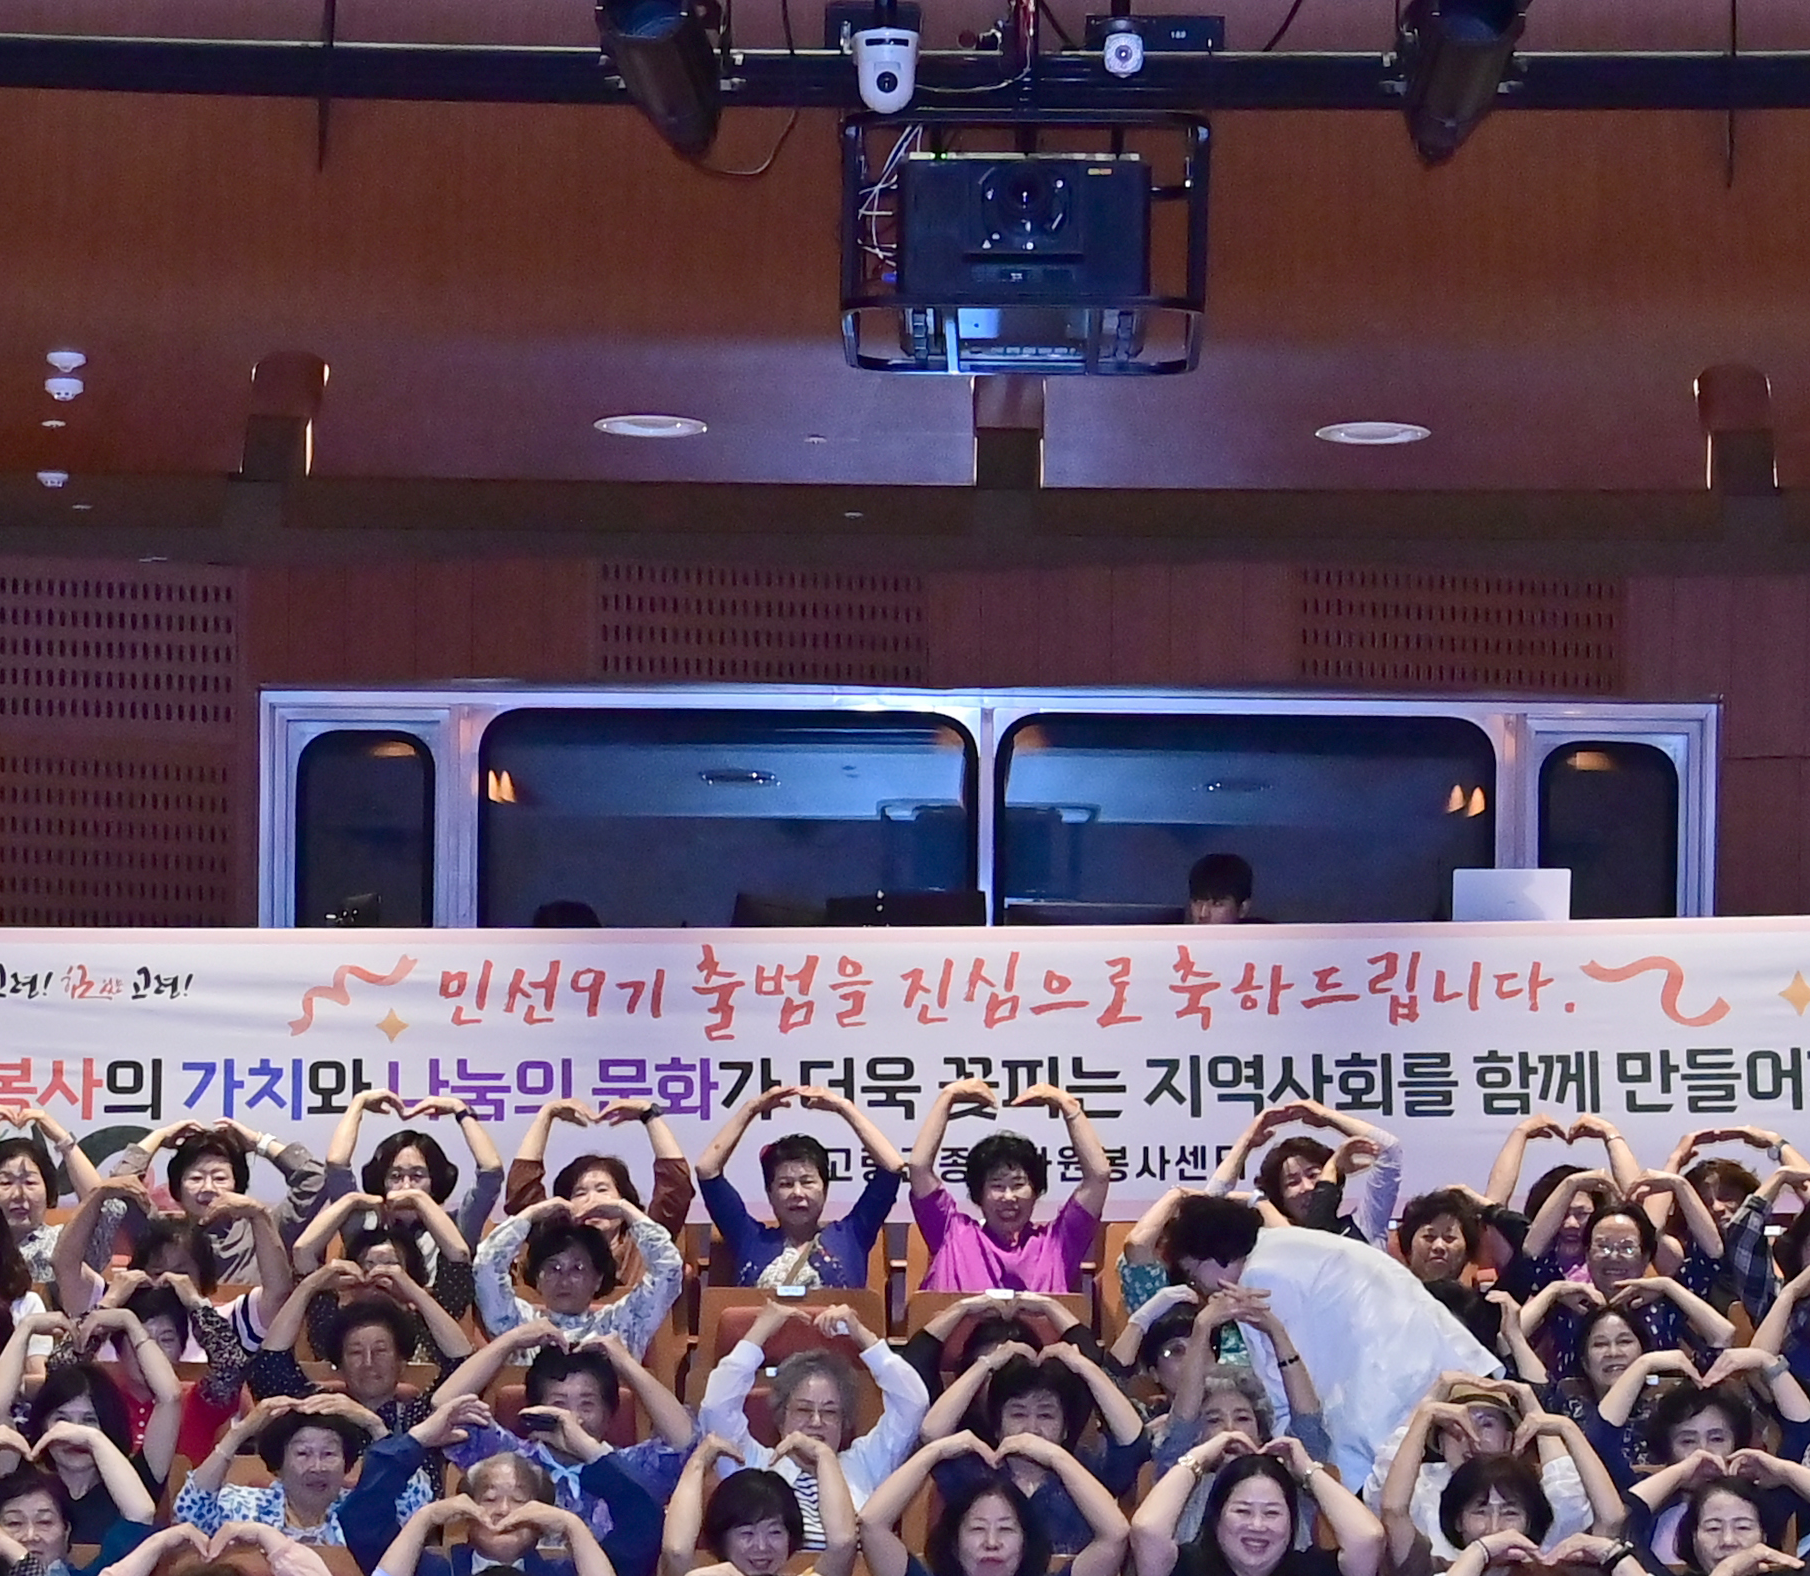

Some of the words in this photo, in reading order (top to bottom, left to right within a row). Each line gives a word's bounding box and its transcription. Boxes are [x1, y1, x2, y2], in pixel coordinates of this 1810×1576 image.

[438, 958, 663, 1026] 민선9기
[692, 944, 877, 1041] 출범을
[900, 951, 1142, 1028] 진심으로
[1168, 944, 1576, 1029] 축하드립니다.
[182, 1056, 372, 1121] 가치와
[388, 1056, 572, 1122] 나눔의
[591, 1056, 781, 1121] 문화가
[800, 1056, 921, 1121] 더욱
[1143, 1052, 1459, 1118] 지역사회를
[1473, 1049, 1601, 1116] 함께
